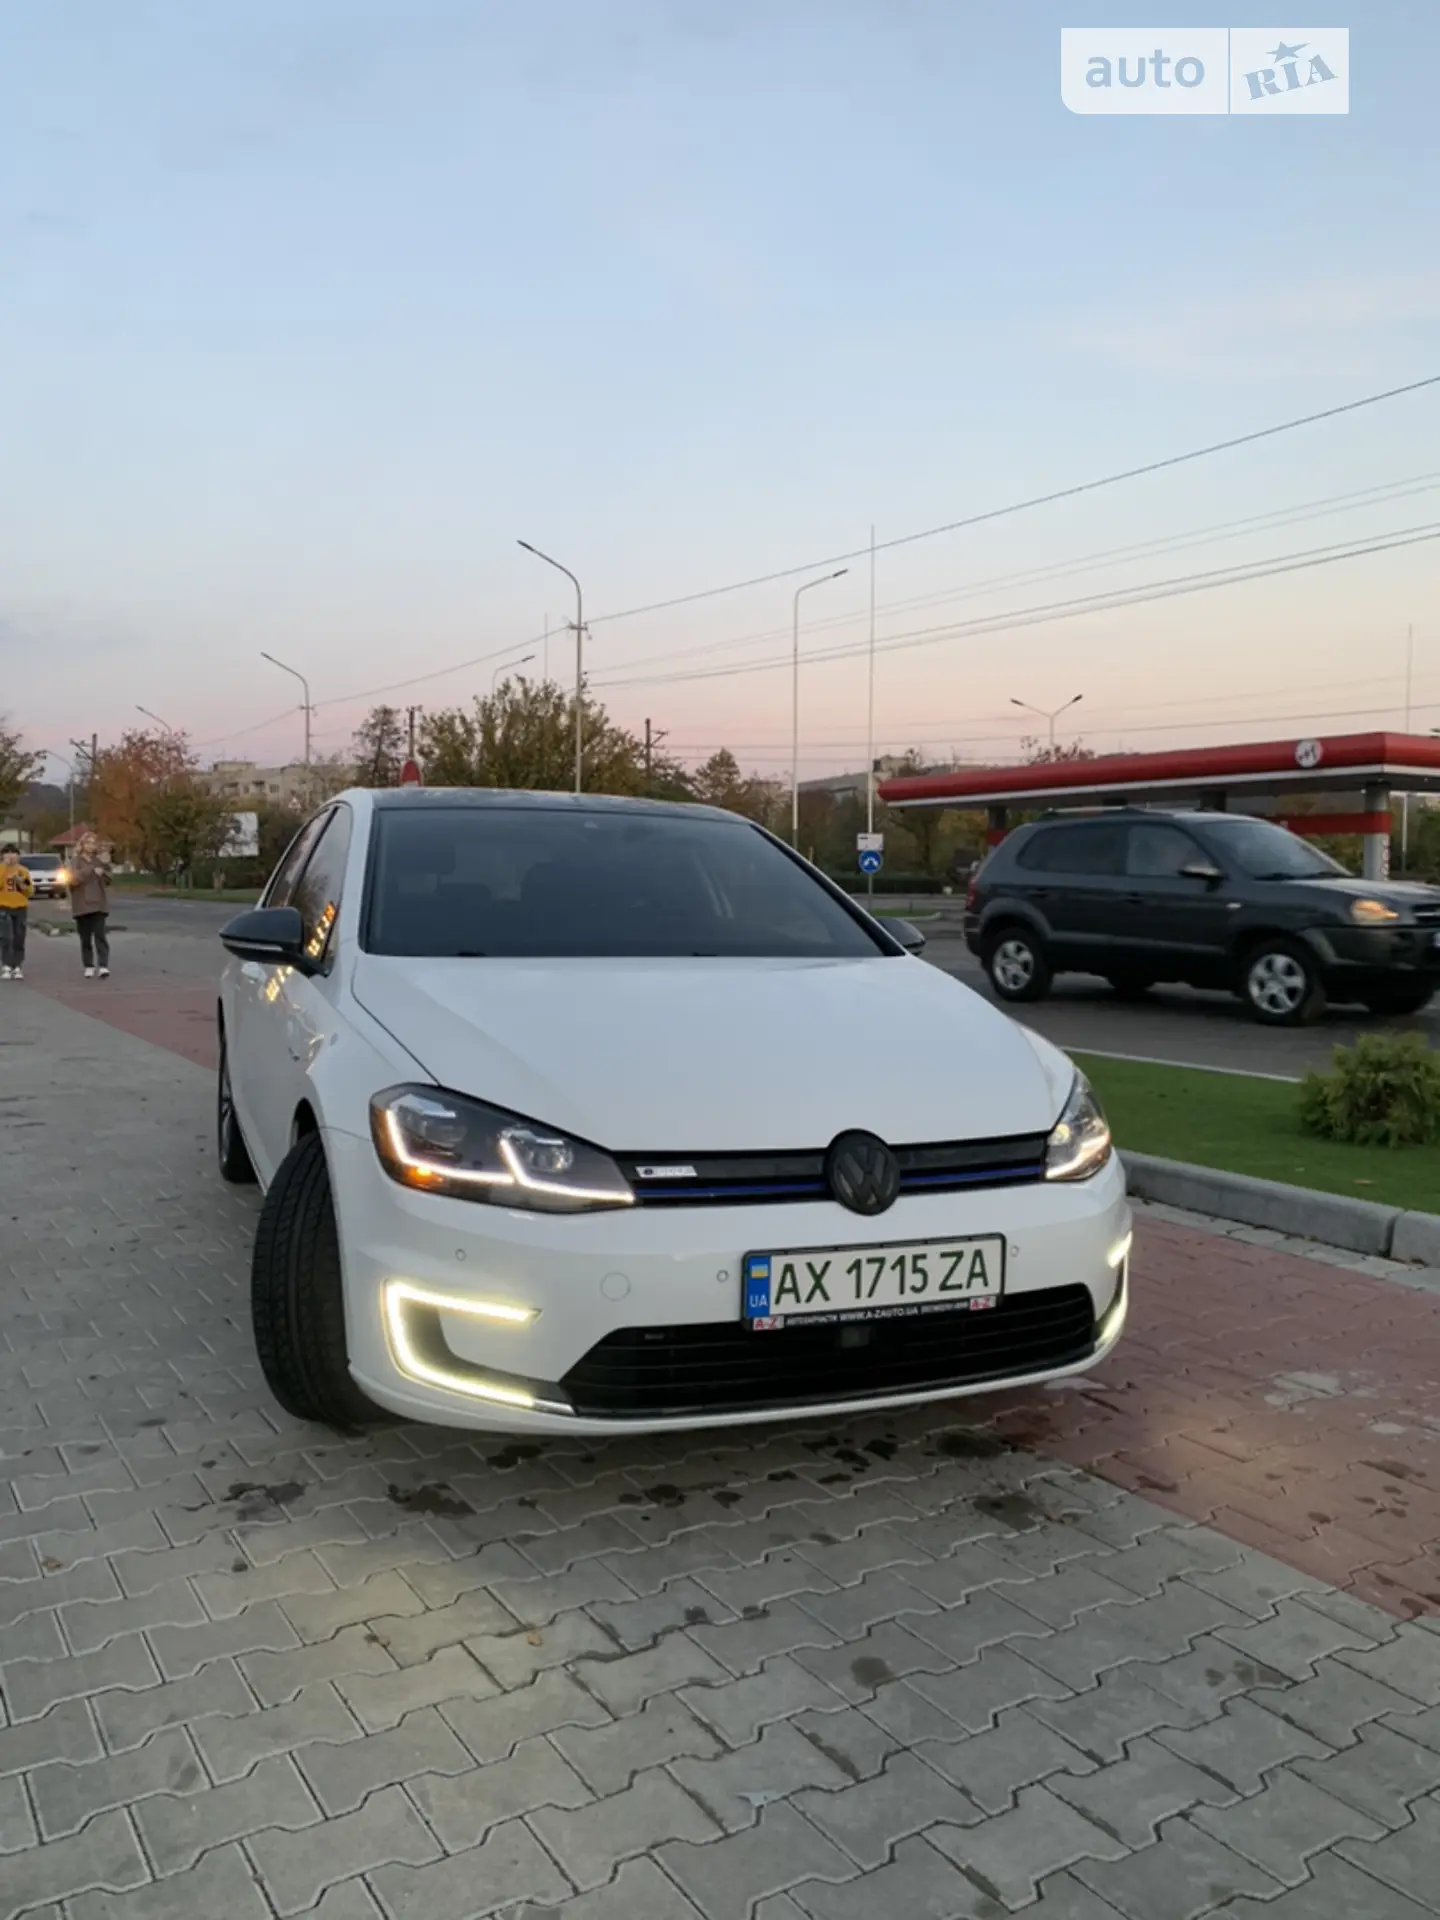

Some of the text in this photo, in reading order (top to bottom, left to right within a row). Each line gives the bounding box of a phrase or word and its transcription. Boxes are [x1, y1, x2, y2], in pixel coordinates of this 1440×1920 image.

[774, 1249, 989, 1305] AX 1715 ZA
[750, 1294, 768, 1307] UA
